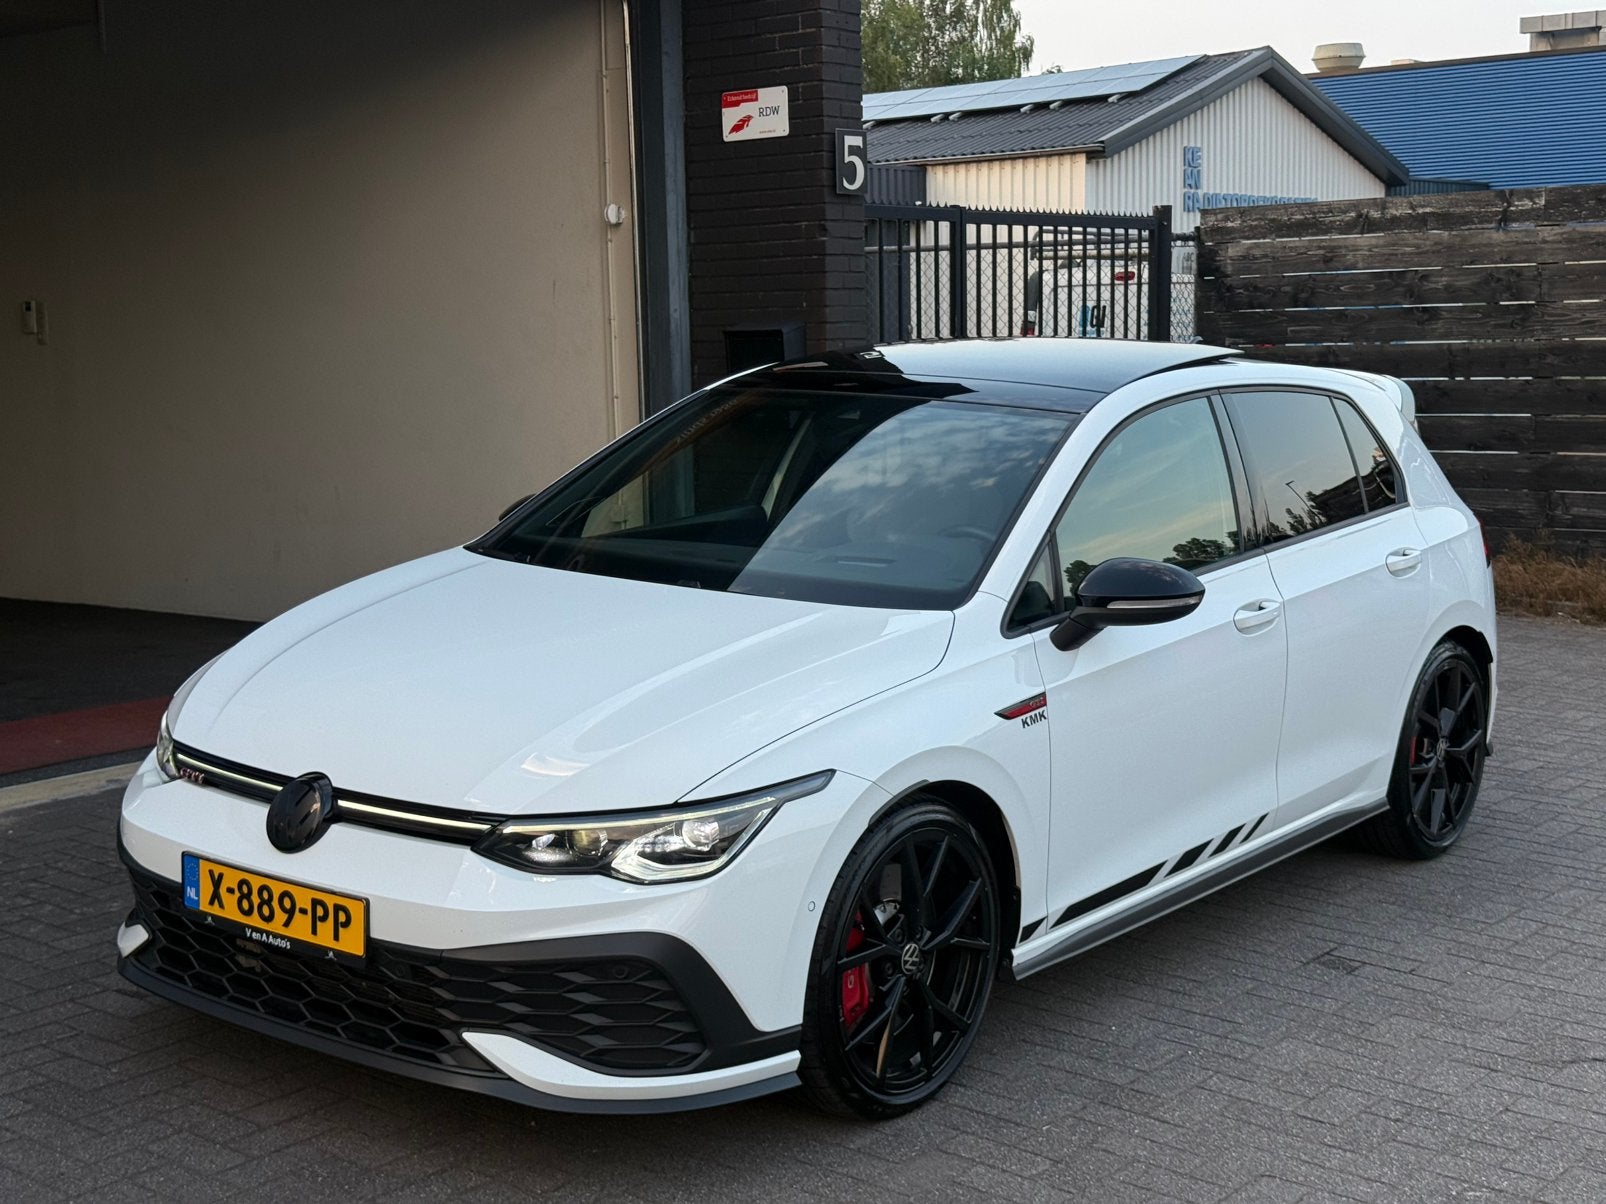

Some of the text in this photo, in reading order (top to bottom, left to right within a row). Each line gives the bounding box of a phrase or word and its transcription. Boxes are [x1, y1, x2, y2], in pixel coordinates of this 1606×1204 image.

[758, 105, 780, 117] RDW
[843, 135, 865, 190] 5
[1021, 709, 1047, 729] KMK
[186, 886, 199, 901] NL
[207, 868, 352, 942] X-889-PP
